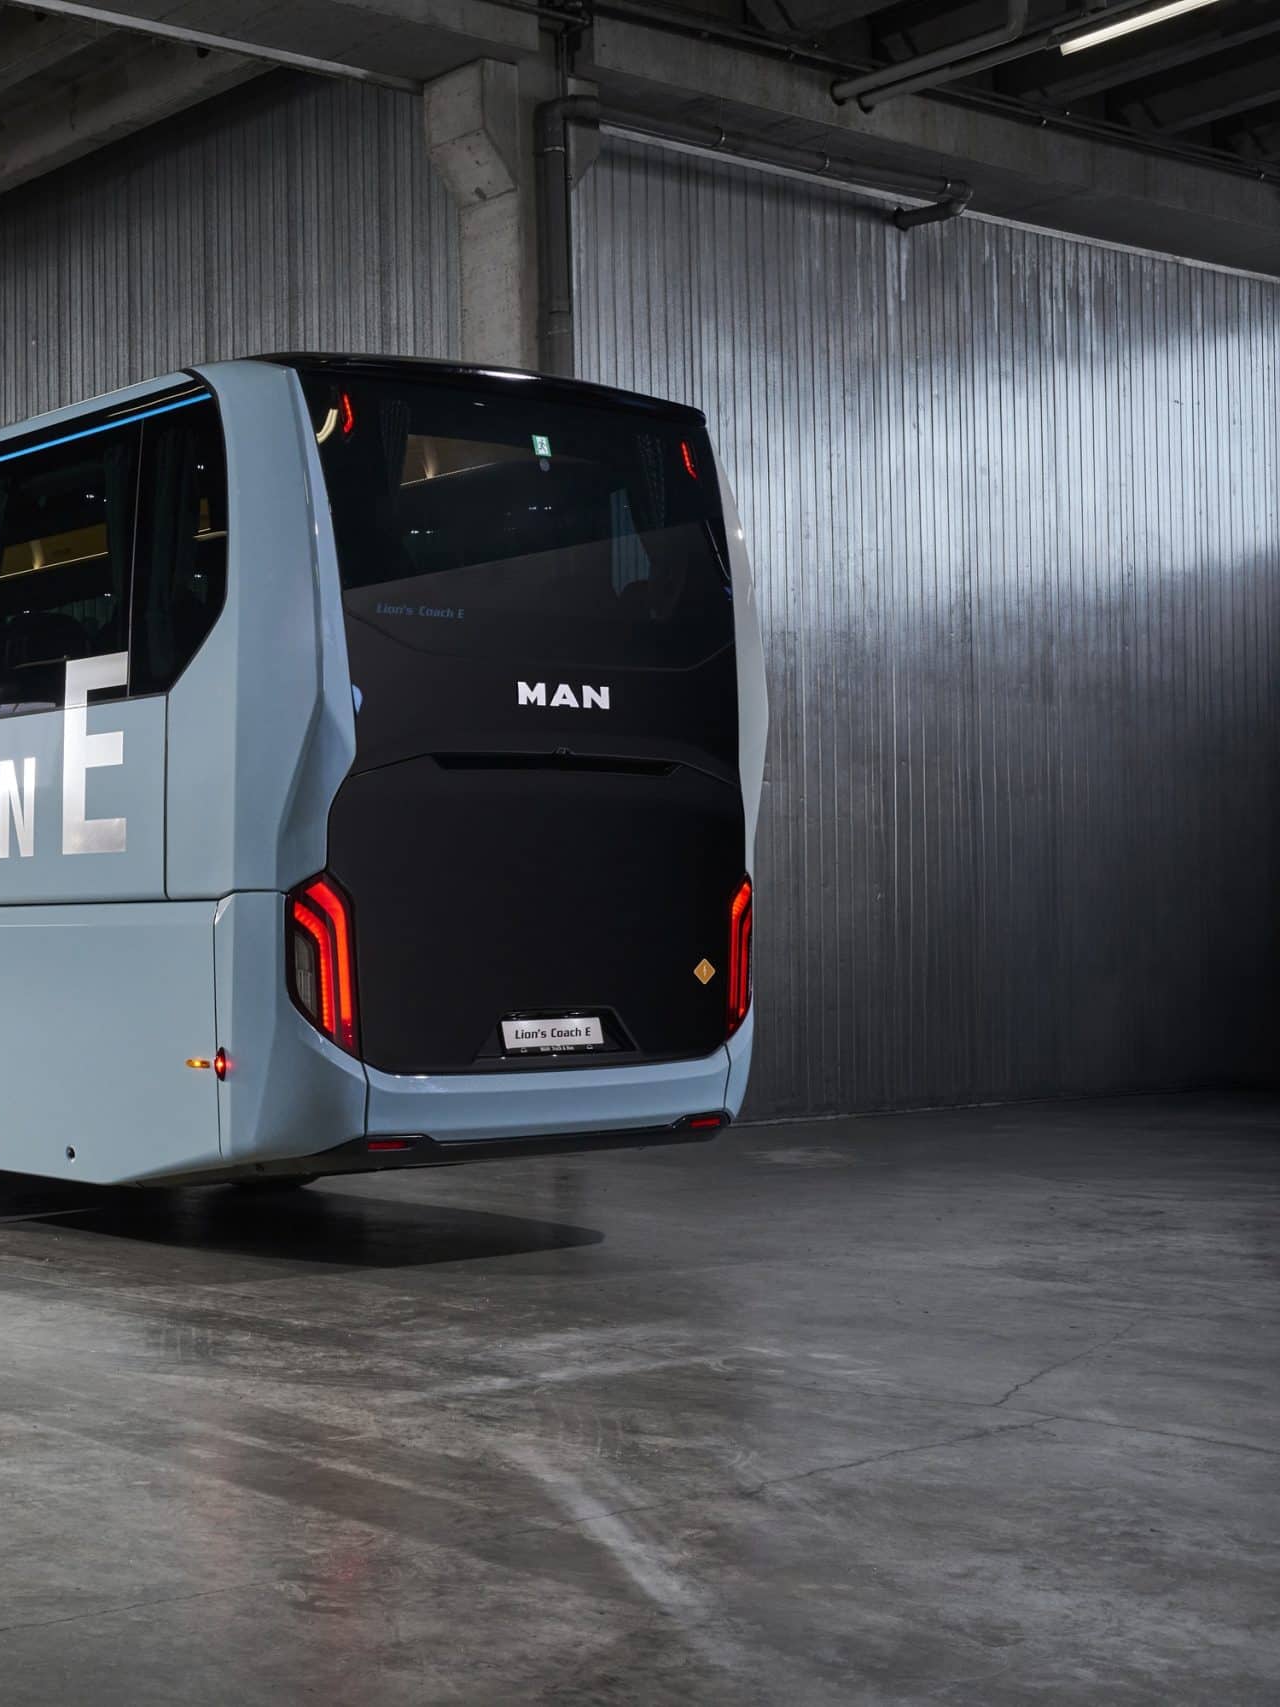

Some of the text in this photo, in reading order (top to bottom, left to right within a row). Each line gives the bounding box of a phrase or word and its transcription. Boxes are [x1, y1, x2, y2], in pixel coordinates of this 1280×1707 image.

[376, 603, 465, 619] Lion's Coach E
[517, 681, 610, 709] MAN
[62, 651, 130, 855] E
[515, 1026, 591, 1039] Lion's Coach E
